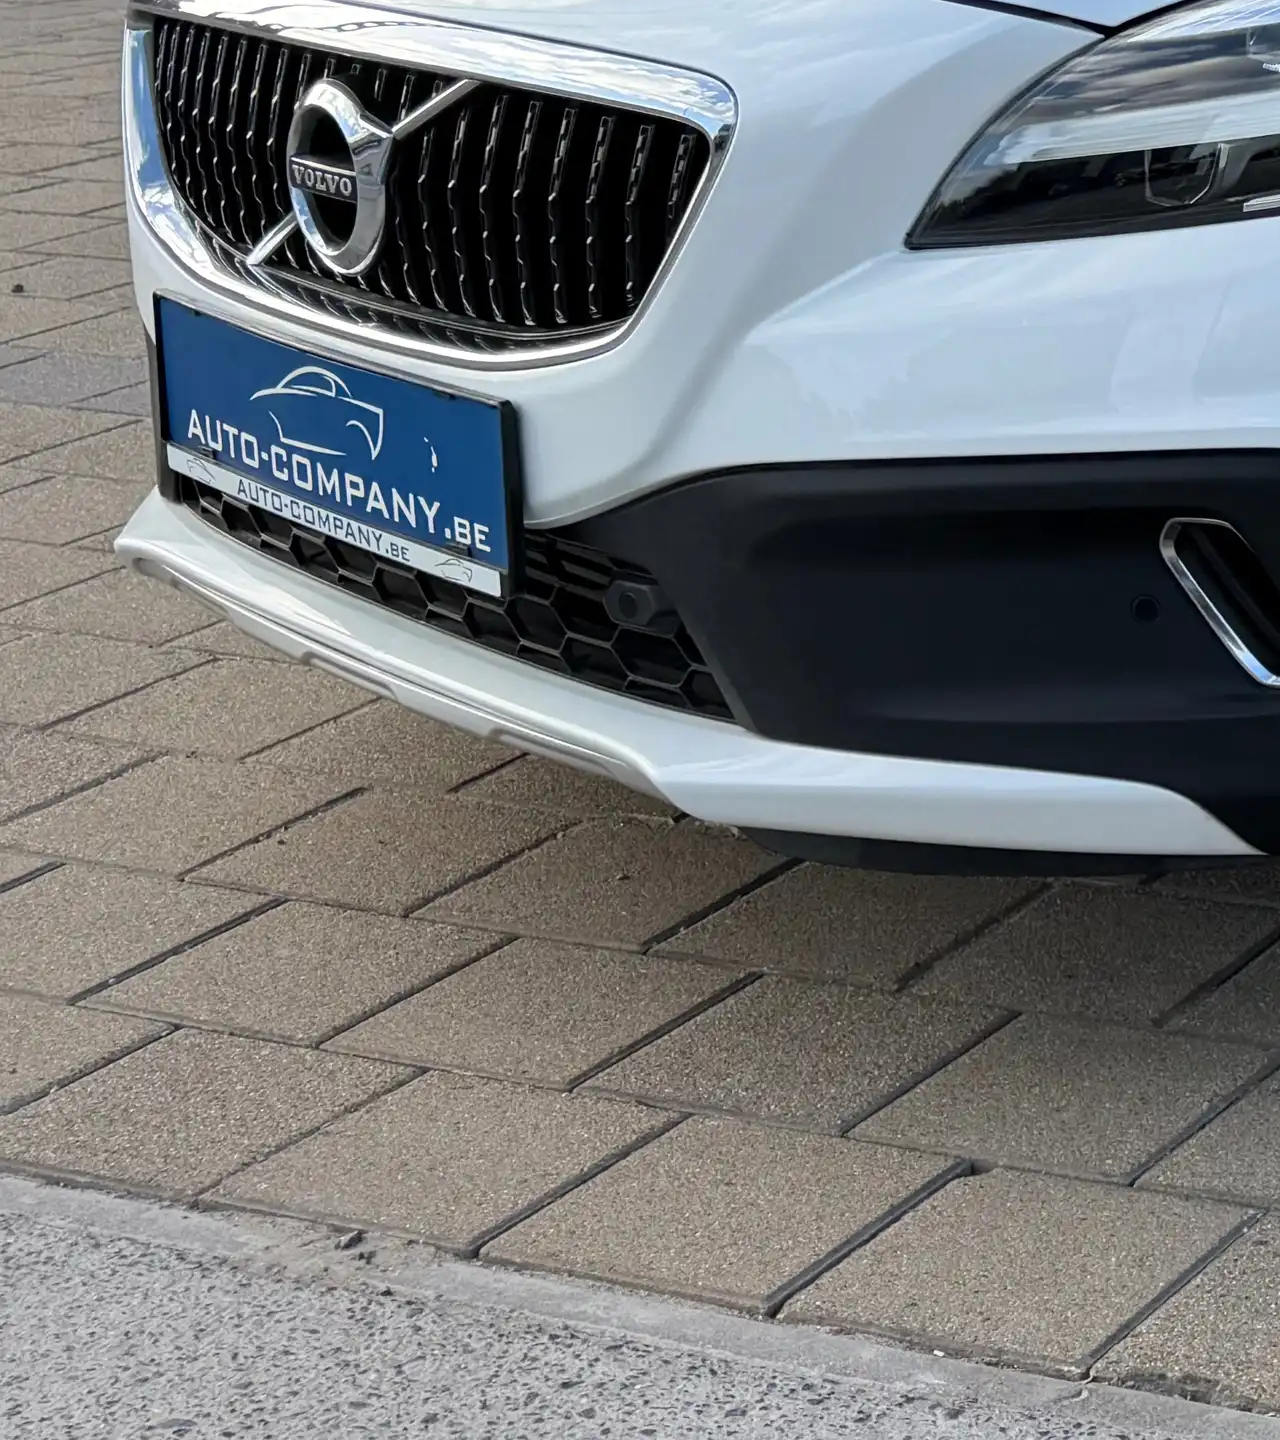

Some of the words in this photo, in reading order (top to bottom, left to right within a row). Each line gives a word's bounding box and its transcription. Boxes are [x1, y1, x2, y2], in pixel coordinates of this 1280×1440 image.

[291, 164, 353, 197] VOLVO
[187, 409, 491, 553] AUTO-COMPANY.BE
[237, 479, 411, 563] AUTO-COMPANY.BE
